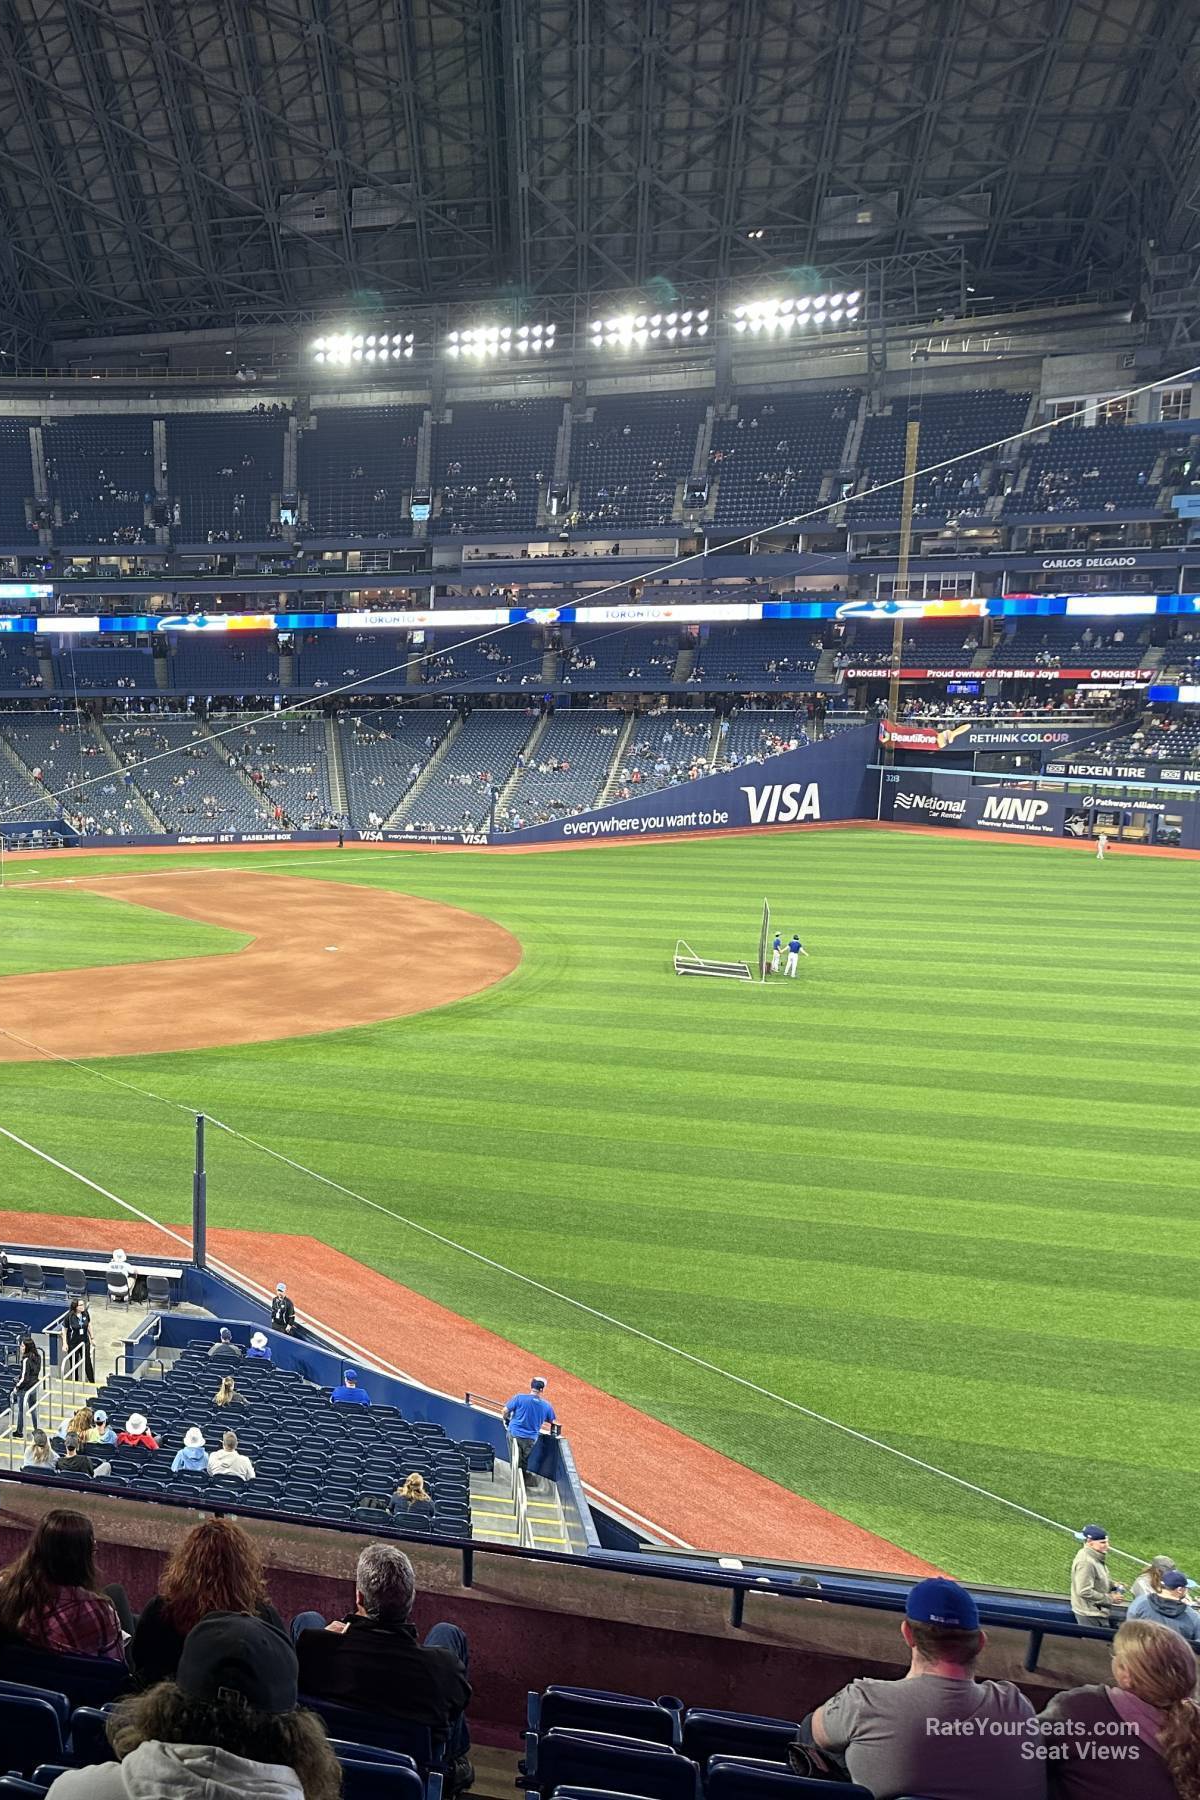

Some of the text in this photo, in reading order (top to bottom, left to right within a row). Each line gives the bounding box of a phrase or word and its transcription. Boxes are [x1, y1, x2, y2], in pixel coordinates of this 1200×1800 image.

[1042, 557, 1136, 568] CARLOS DELGADO
[606, 610, 661, 618] TORONTO
[364, 616, 415, 624] TORONTO
[986, 670, 995, 678] of
[996, 670, 1013, 678] the
[1013, 670, 1035, 678] Blue
[1036, 670, 1059, 679] Jays
[1101, 670, 1136, 678] ROGERS
[891, 732, 936, 743] BeautiTone
[970, 733, 1069, 743] RETHINK COLOUR
[1068, 765, 1112, 777] NEXEN
[1115, 766, 1146, 778] TIRE
[740, 782, 821, 824] VISA
[1095, 799, 1165, 810] Pathways Alliance
[983, 796, 1049, 823] MNP
[940, 812, 962, 820] Rental
[564, 810, 729, 836] everywhere you want to be
[977, 820, 1002, 828] Wherever
[1002, 821, 1025, 829] Business
[1026, 823, 1041, 831] Takes
[357, 831, 383, 841] VISA
[461, 834, 488, 844] VISA
